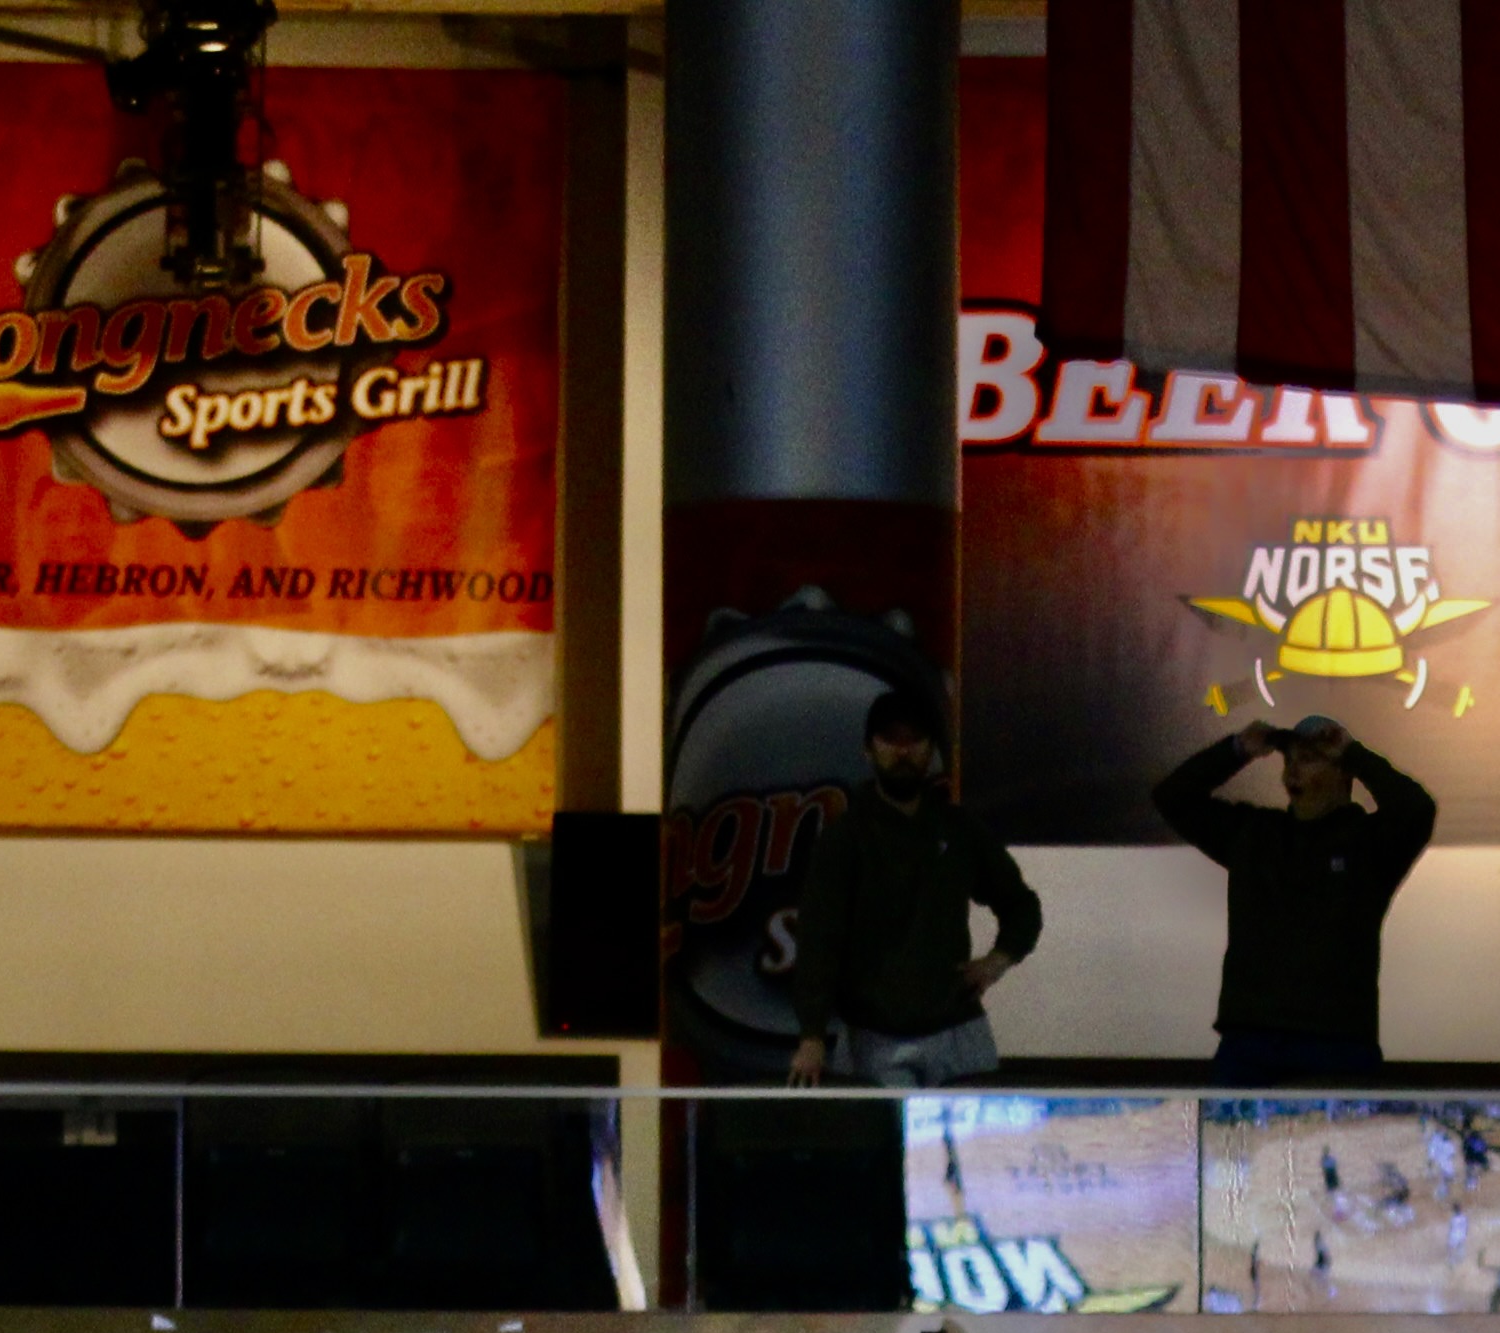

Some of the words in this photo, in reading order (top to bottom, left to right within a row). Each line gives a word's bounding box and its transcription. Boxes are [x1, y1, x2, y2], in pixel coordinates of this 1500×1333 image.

[160, 384, 337, 450] Sports
[352, 359, 484, 419] Grill
[1294, 520, 1388, 544] NKU
[34, 562, 214, 602] HEBRON,
[228, 566, 315, 598] AND
[328, 568, 554, 601] RICHWOOD
[1243, 546, 1440, 609] NORSE
